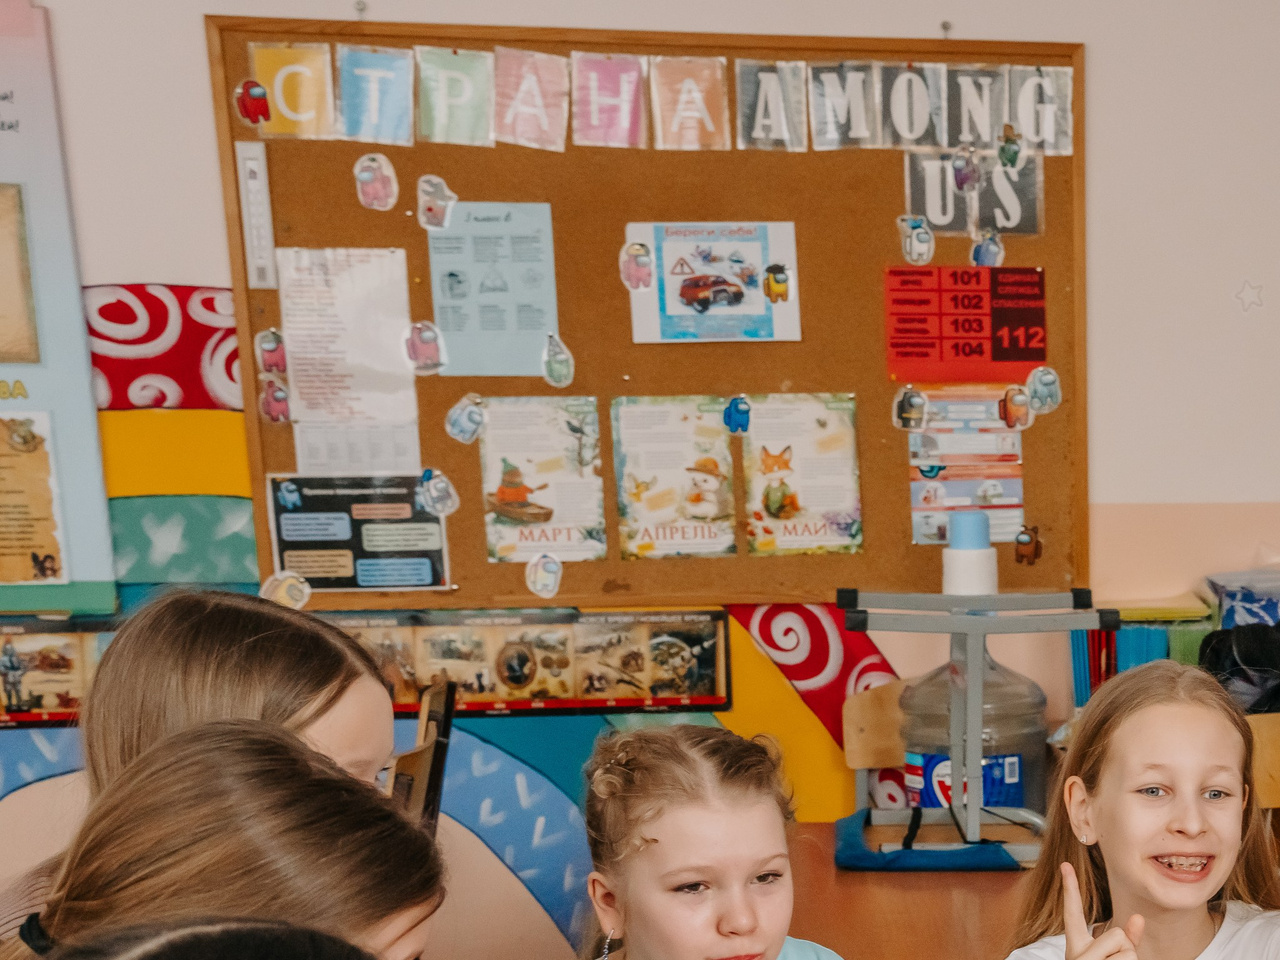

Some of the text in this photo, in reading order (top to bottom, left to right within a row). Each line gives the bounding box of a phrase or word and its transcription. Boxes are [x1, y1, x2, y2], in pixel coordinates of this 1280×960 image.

[273, 62, 1059, 144] СТРАНА AMONG
[923, 158, 1021, 229] US
[951, 271, 981, 285] 101
[951, 295, 984, 309] 102
[951, 318, 984, 333] 103
[997, 326, 1044, 348] 112
[951, 342, 985, 357] 104
[518, 526, 576, 542] МАРТ
[640, 523, 718, 541] АПРЕЛЬ
[782, 521, 828, 537] МАЙ
